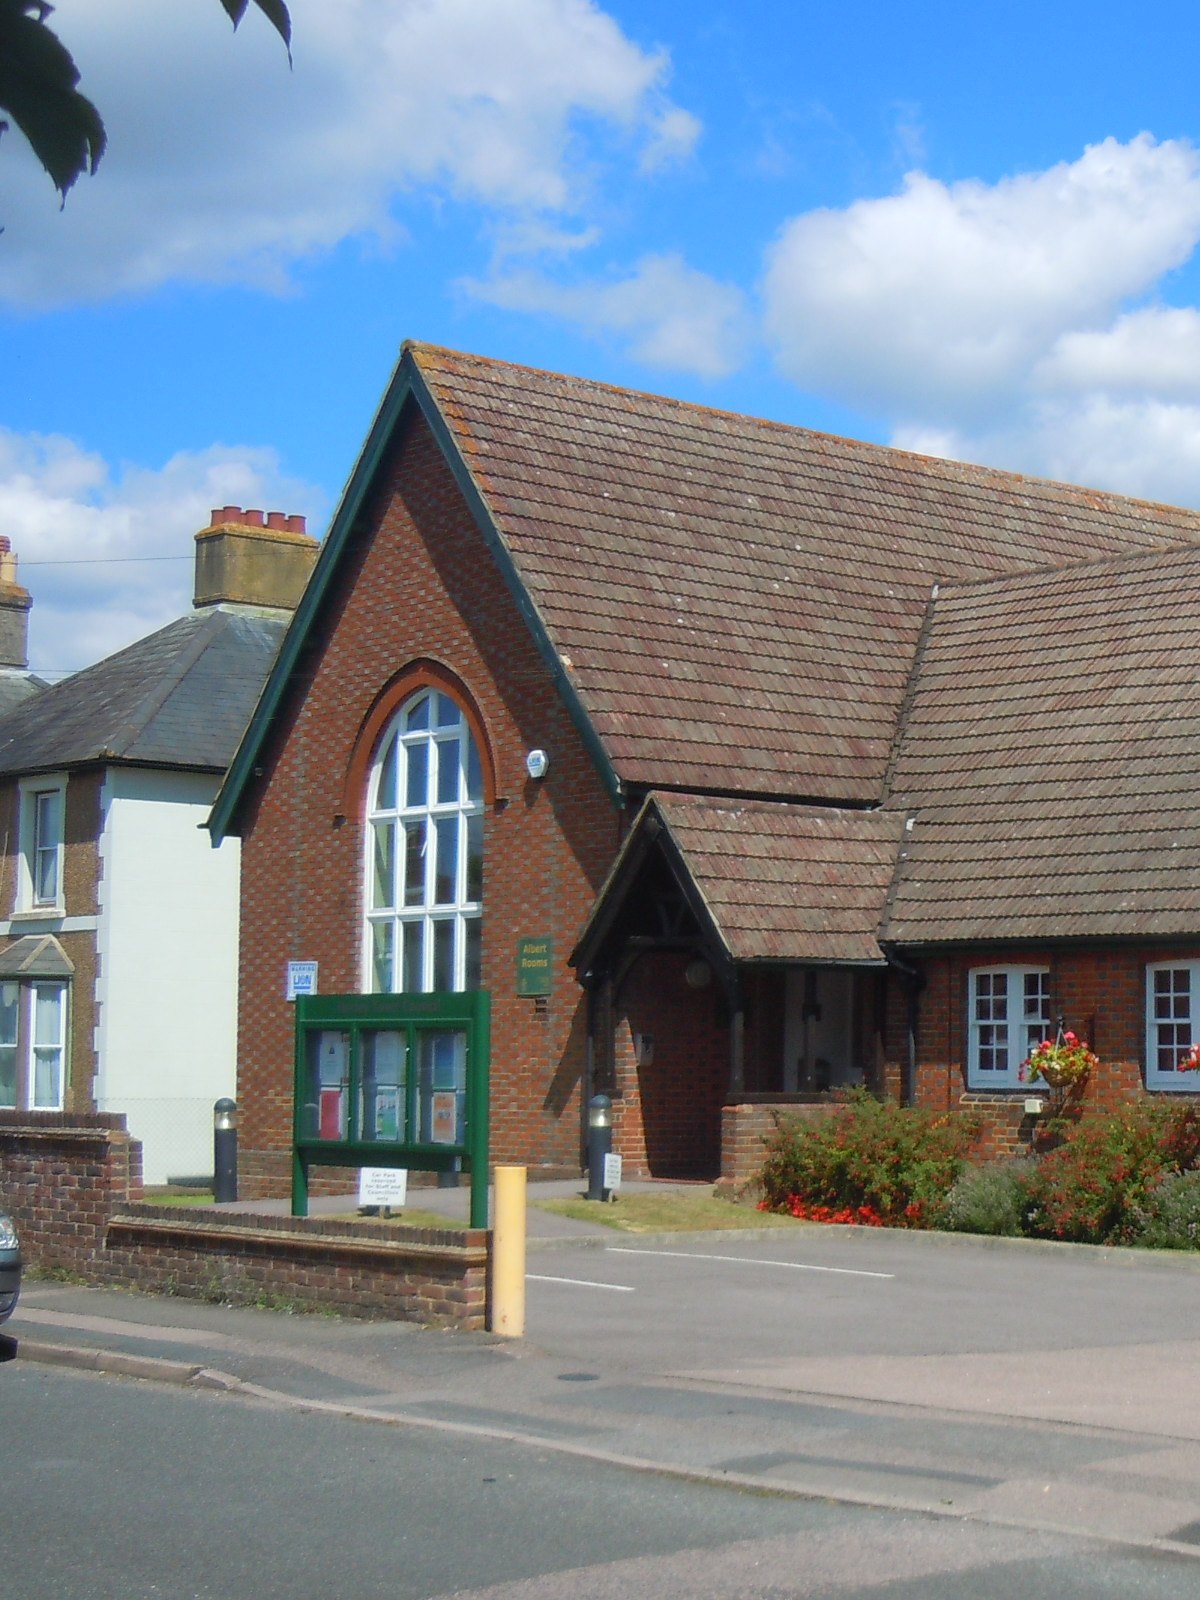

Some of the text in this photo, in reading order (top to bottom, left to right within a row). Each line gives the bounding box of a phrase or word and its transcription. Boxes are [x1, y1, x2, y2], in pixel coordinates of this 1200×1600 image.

[523, 944, 548, 954] Albert
[521, 958, 548, 968] Rooms
[293, 974, 312, 985] LION
